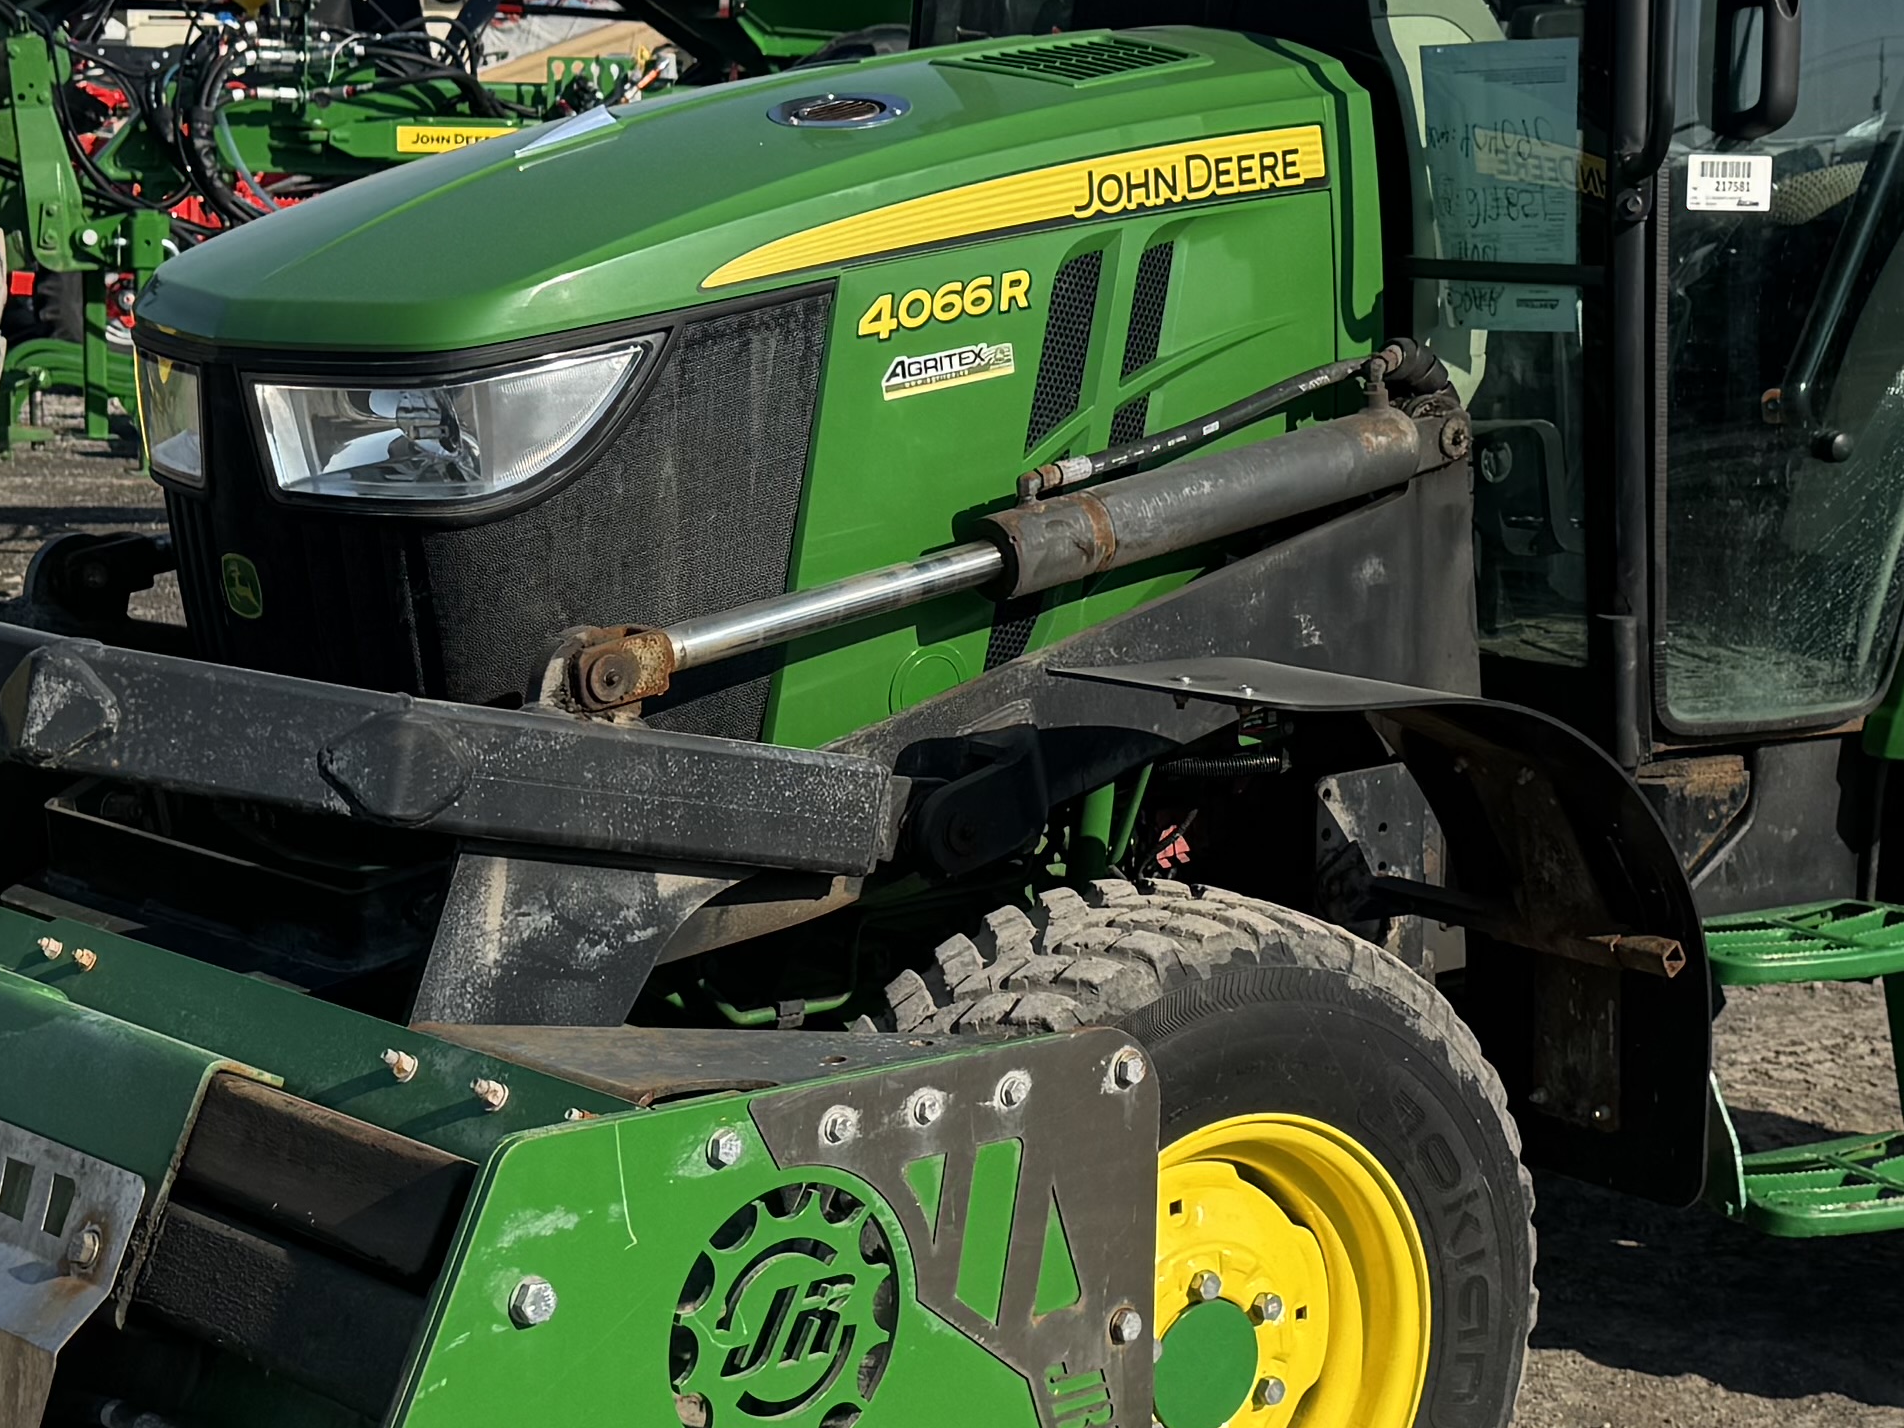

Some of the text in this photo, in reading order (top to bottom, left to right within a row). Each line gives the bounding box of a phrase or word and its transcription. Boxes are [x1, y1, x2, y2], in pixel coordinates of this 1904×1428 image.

[1073, 147, 1301, 212] JOHN DEERE
[1714, 180, 1751, 193] 217581
[884, 347, 986, 383] AGRITEX
[719, 1272, 857, 1381] JR
